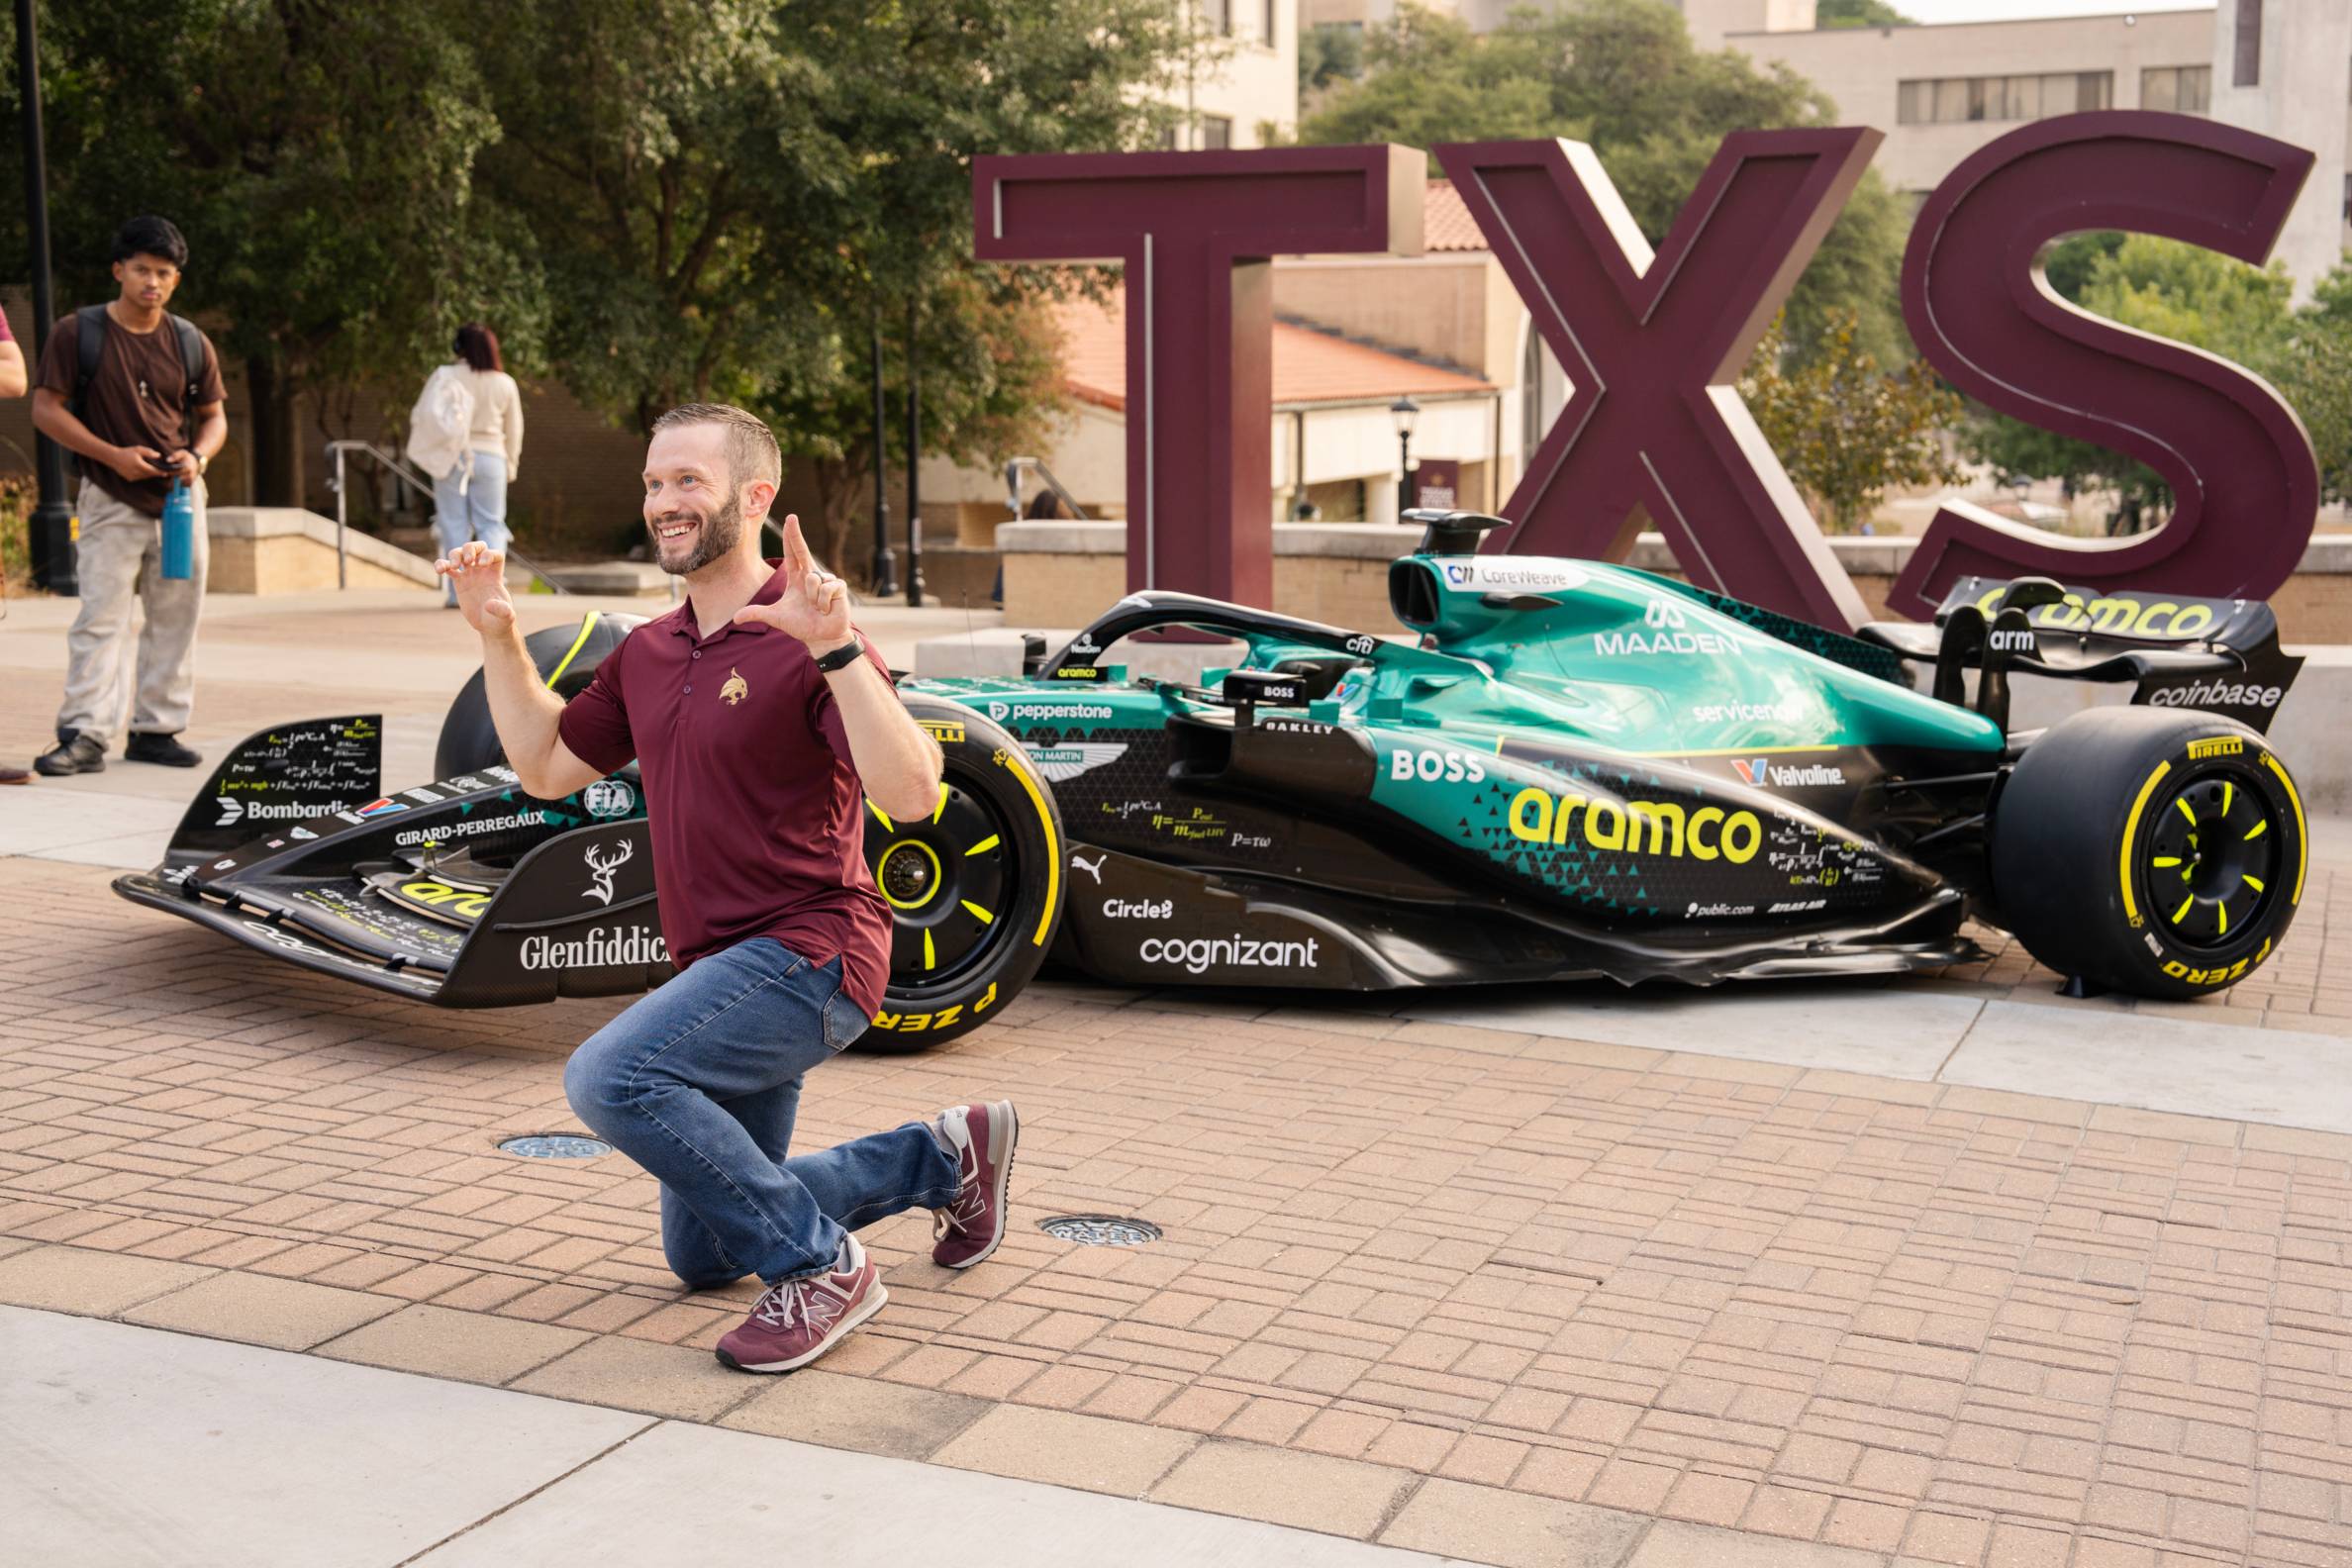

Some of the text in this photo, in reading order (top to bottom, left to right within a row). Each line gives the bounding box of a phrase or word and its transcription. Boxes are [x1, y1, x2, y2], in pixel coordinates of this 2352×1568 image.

[1482, 568, 1567, 587] CoreWeave
[1346, 636, 1375, 654] citi
[1990, 631, 2035, 650] arm
[1057, 667, 1097, 677] aramco
[1264, 686, 1295, 698] BOSS
[2149, 678, 2282, 708] coinbase
[1013, 703, 1113, 720] pepperstone
[1266, 722, 1333, 735] OAKLEY
[1045, 751, 1081, 760] MARTIN
[2187, 736, 2243, 760] PIRELLI
[1391, 749, 1486, 783] BOSS
[247, 800, 353, 820] Bombardi
[396, 811, 546, 846] GIRARD-PERREGAUX
[1509, 788, 1762, 864] aramco
[1697, 903, 1755, 917] public.com
[520, 926, 671, 970] Glenfiddic
[1139, 932, 1320, 974] cognizant
[2162, 957, 2250, 985] ZERO
[871, 1004, 964, 1031] ZER
